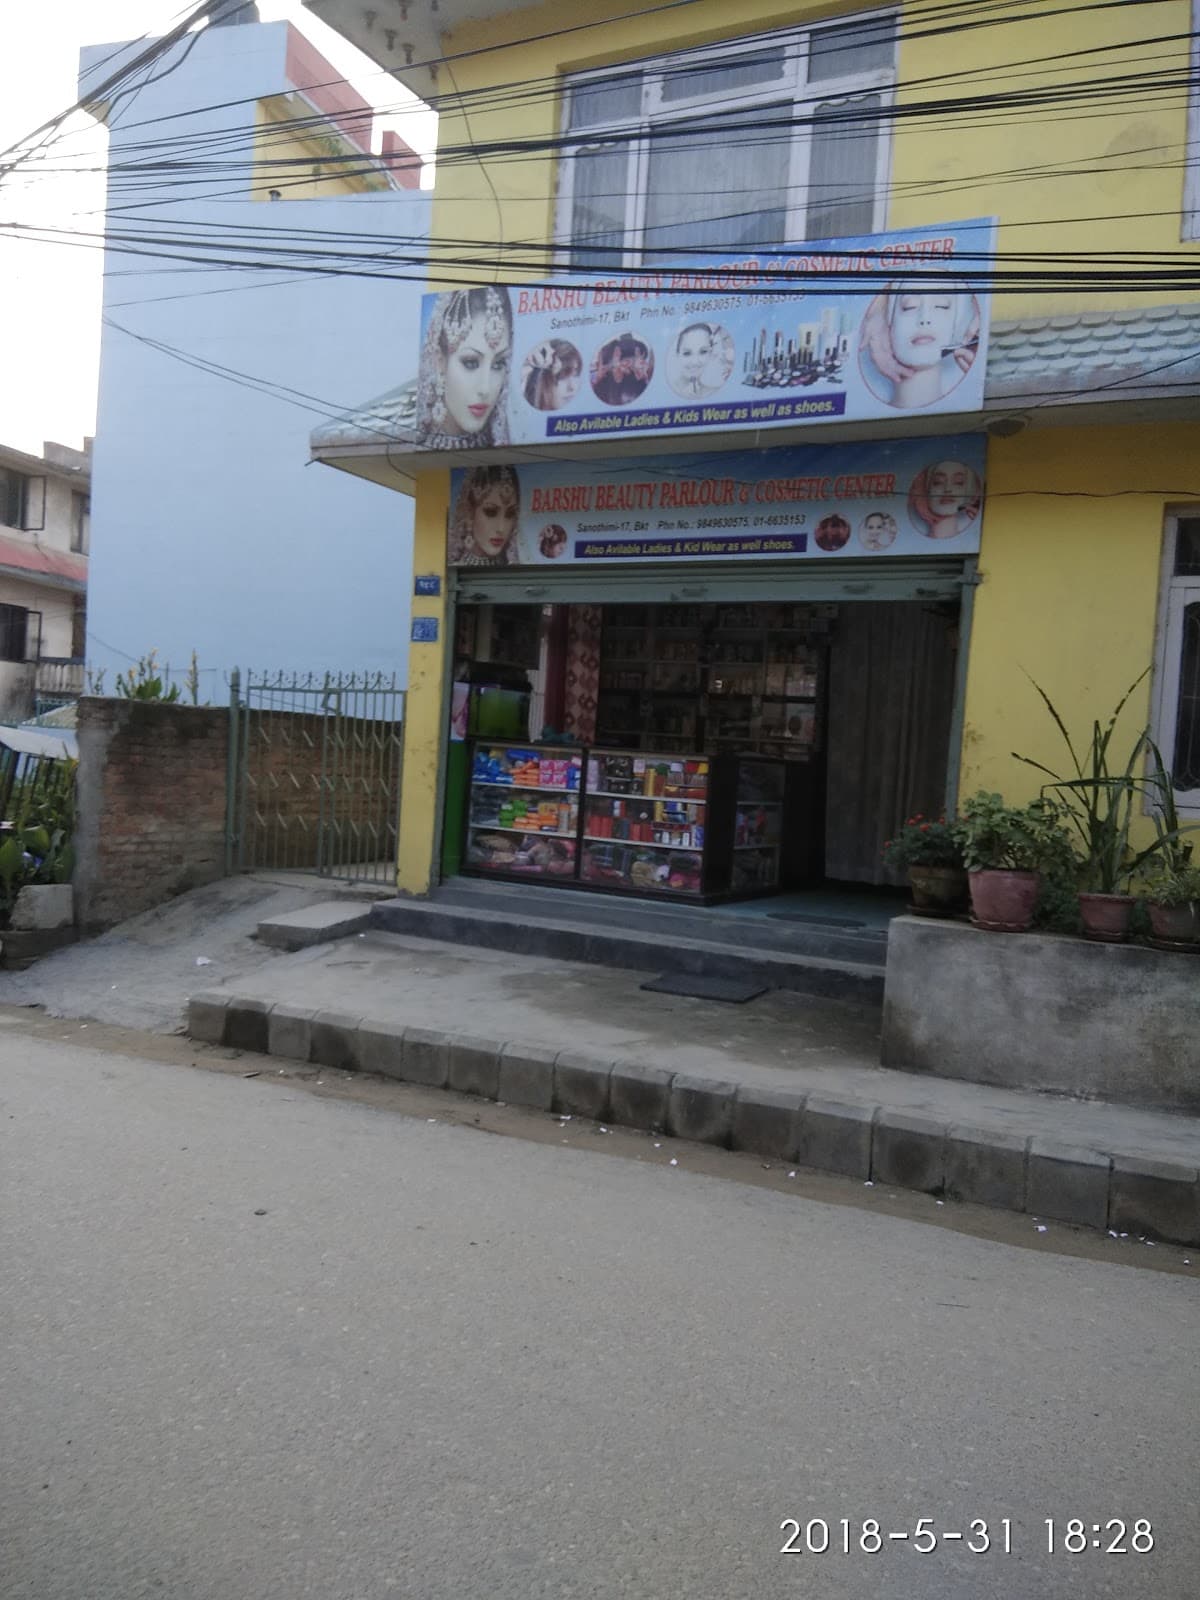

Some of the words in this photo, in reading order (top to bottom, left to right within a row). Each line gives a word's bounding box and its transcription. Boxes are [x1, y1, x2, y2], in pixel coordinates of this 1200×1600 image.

[518, 283, 588, 314] BARSHU
[593, 276, 664, 306] BEAUTY
[669, 261, 760, 294] PARLOUR
[784, 247, 875, 280] COSMETIC
[880, 237, 955, 268] CENTER
[555, 420, 578, 433] Also
[579, 417, 621, 431] Avilable
[623, 414, 659, 427] Ladies
[662, 412, 671, 424] &
[674, 409, 699, 423] Kids
[703, 407, 731, 421] Wear
[734, 407, 748, 419] as
[752, 403, 776, 418] well
[778, 404, 792, 416] as
[794, 400, 835, 414] shoes.
[532, 487, 590, 512] BARSHU
[596, 484, 657, 510] BEAUTY
[660, 479, 734, 506] PARLOUR
[756, 477, 830, 502] COSMETIC
[835, 474, 895, 498] CENTER
[584, 545, 604, 555] Also
[642, 543, 672, 553] Ladies
[674, 542, 681, 553] &
[683, 541, 699, 552] Kid
[702, 540, 727, 552] Wear
[728, 542, 739, 551] as
[741, 540, 761, 551] well
